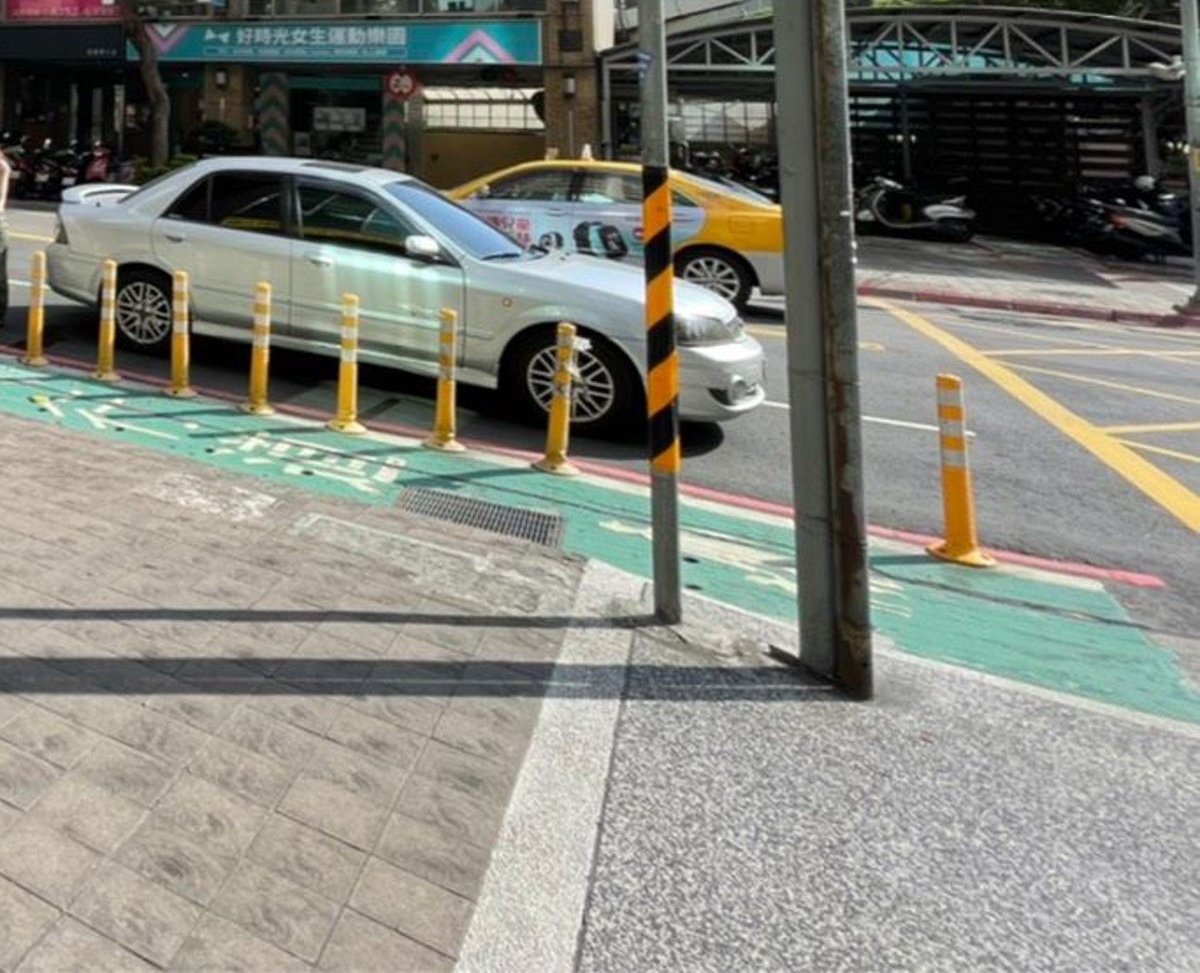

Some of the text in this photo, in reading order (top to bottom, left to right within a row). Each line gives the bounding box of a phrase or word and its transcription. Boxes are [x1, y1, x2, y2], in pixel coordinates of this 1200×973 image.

[236, 26, 408, 46] 好時光女生運動樂園
